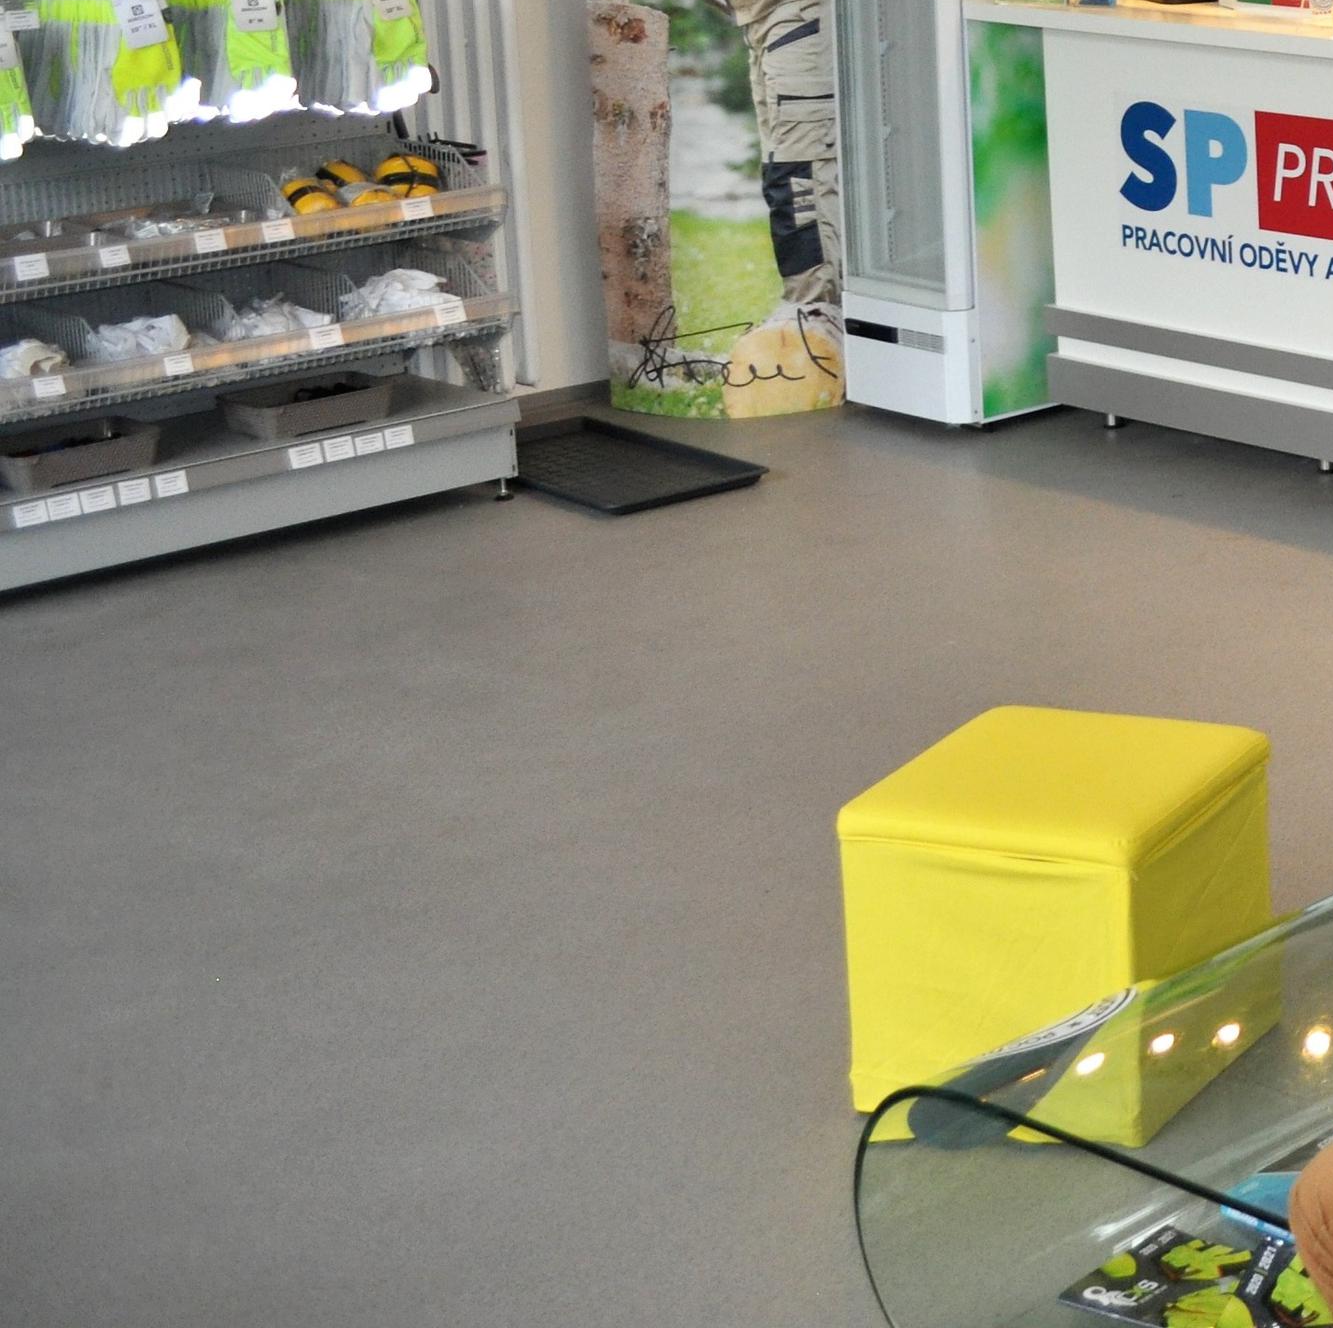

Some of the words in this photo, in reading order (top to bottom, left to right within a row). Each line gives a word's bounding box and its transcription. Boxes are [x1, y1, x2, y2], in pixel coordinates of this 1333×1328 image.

[1119, 101, 1248, 217] SP
[1121, 224, 1234, 265] PRACOVNÍ
[1240, 239, 1319, 276] ODĚVY
